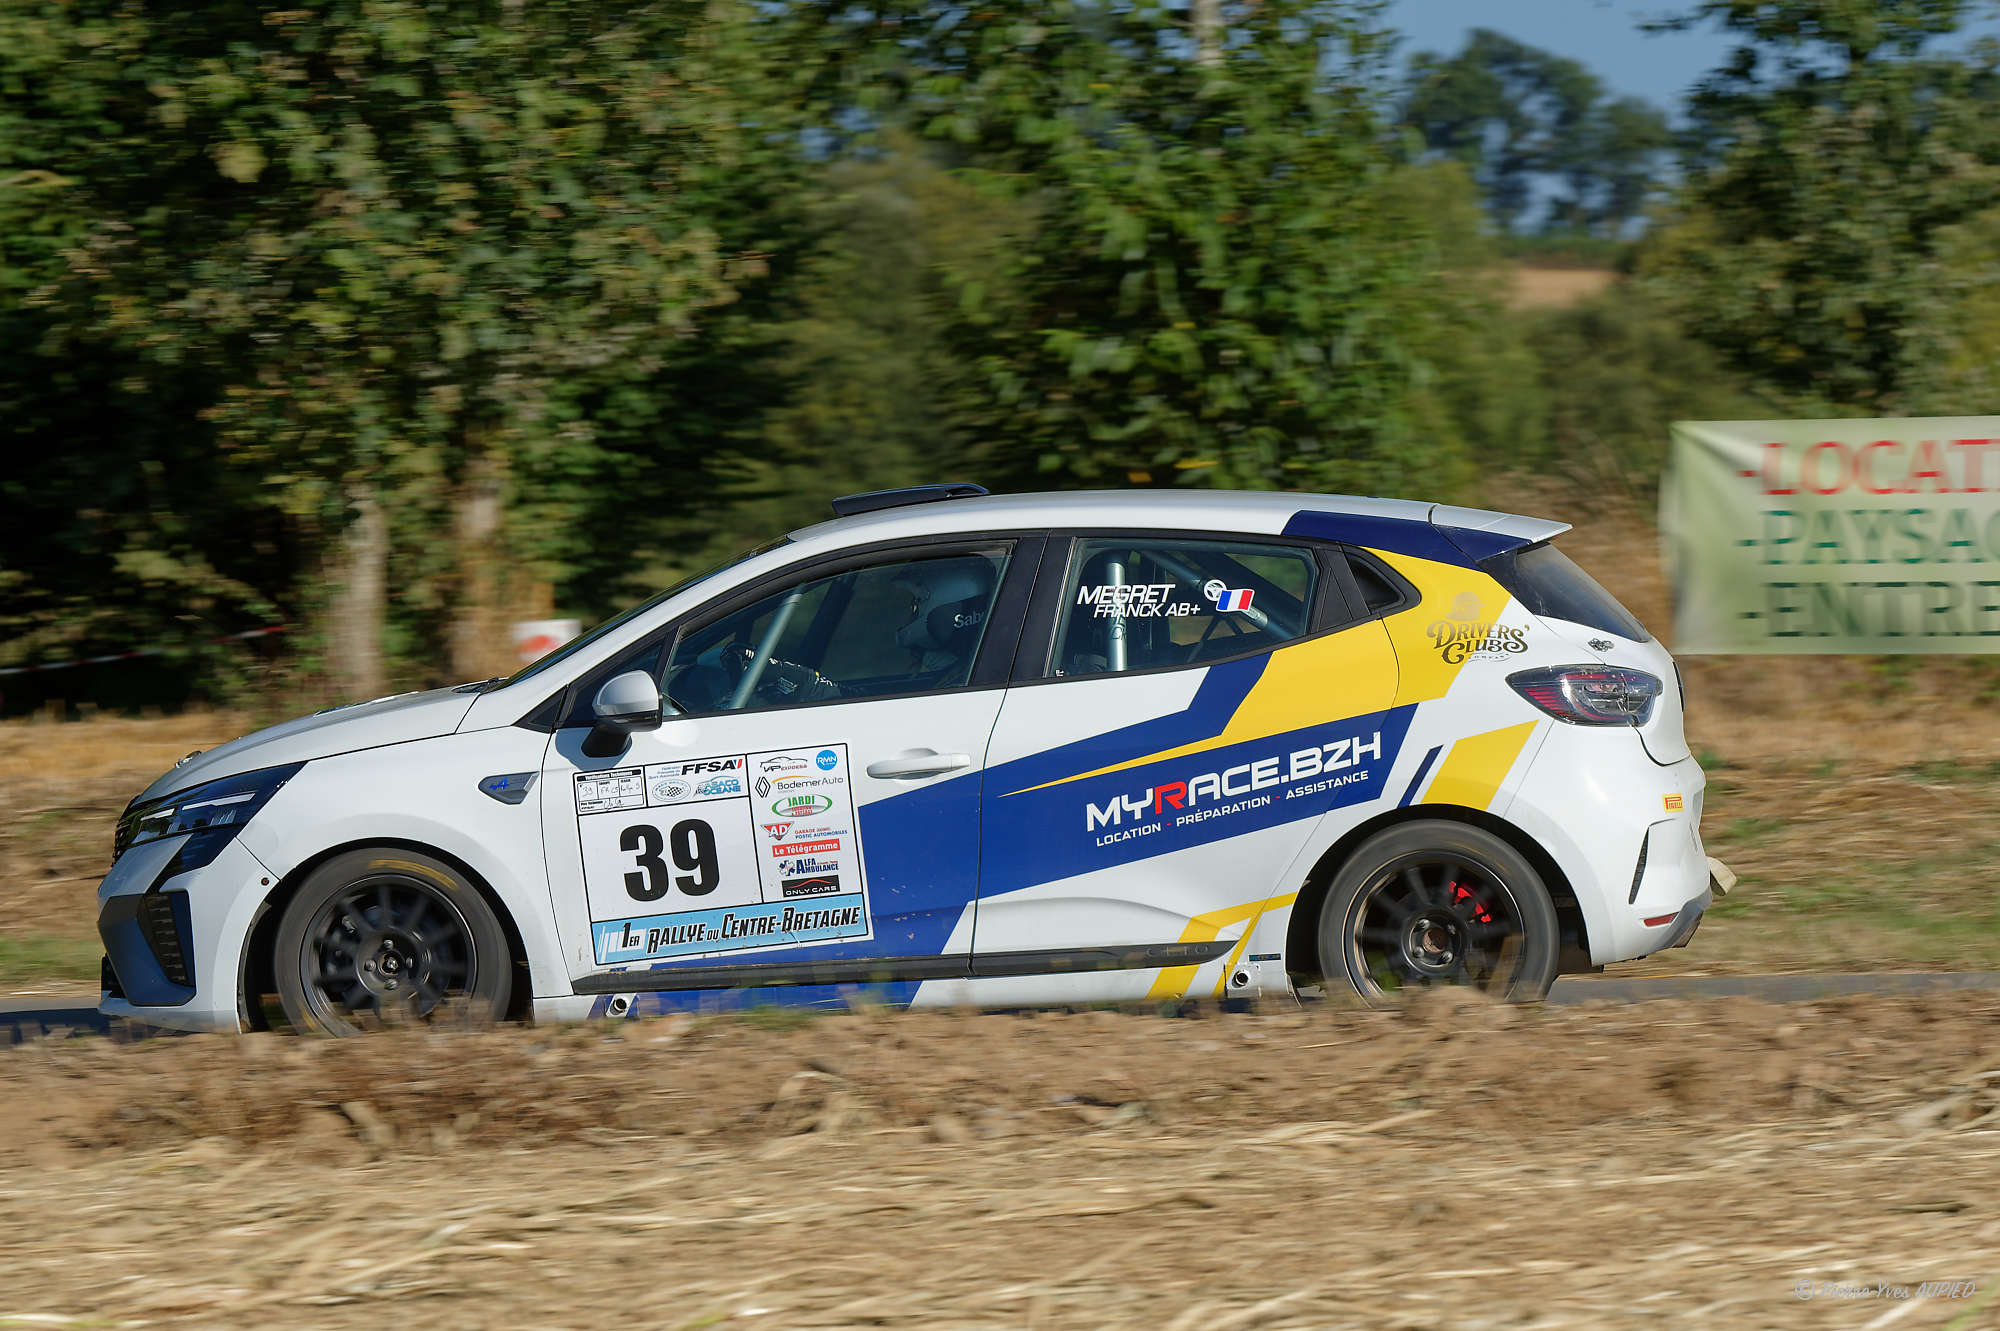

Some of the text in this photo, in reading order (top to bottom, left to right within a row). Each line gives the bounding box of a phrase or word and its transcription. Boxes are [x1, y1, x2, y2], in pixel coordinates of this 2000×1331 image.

[1736, 438, 2000, 496] -LOCAT
[1077, 583, 1176, 605] MEGRET
[954, 610, 984, 628] Sab
[1093, 602, 1201, 618] FRANCK AB+
[681, 759, 735, 776] FFSA
[1086, 731, 1382, 832] MYRACE.BZH
[787, 795, 815, 807] JARDI
[1095, 821, 1162, 847] LOCATION
[1176, 794, 1271, 828] PRÉPARATION
[1285, 769, 1369, 801] ASSISTANCE
[769, 824, 788, 836] AD
[774, 842, 838, 855] Le Télégramme
[619, 818, 720, 902] 39
[785, 888, 810, 896] ONLY
[646, 923, 707, 955] RALLYE
[707, 929, 720, 941] DU
[721, 905, 861, 940] CENTRE-BRETAGNE
